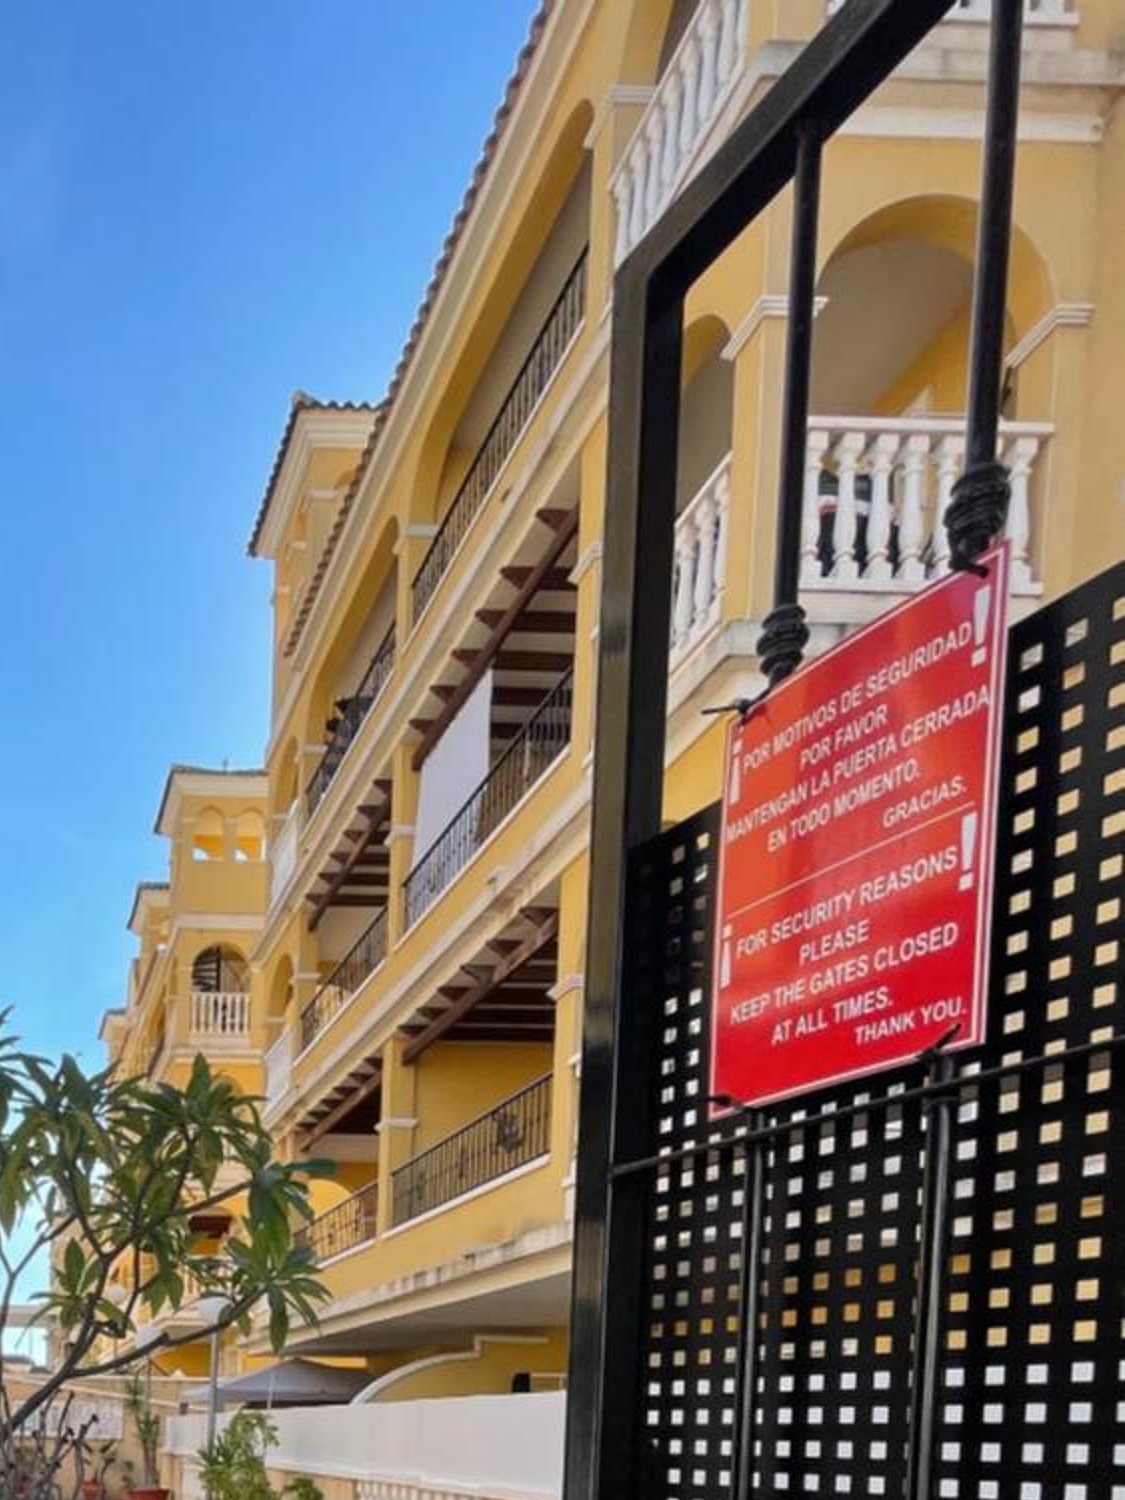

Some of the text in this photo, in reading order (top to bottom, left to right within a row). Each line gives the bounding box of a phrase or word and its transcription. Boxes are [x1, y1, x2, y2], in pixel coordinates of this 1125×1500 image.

[743, 742, 771, 774] POR
[772, 700, 838, 756] MOTIVOS
[840, 682, 864, 713] DE
[865, 621, 972, 699] SEGURIDAD
[799, 704, 888, 771] POR FAVOR
[726, 684, 991, 843] MANTENGAN LA PUERTA CERRADA
[882, 775, 968, 829] GRACIAS.
[767, 757, 921, 853] EN TODO MOMENTO.
[736, 928, 768, 961] FOR
[770, 889, 856, 945] SECURITY
[859, 846, 958, 906] REASONS
[799, 918, 870, 967] PLEASE
[730, 922, 958, 1025] KEEP THE GATES CLOSED
[771, 985, 893, 1046] AT ALL TIMES.
[854, 997, 967, 1045] THANK YOU.
